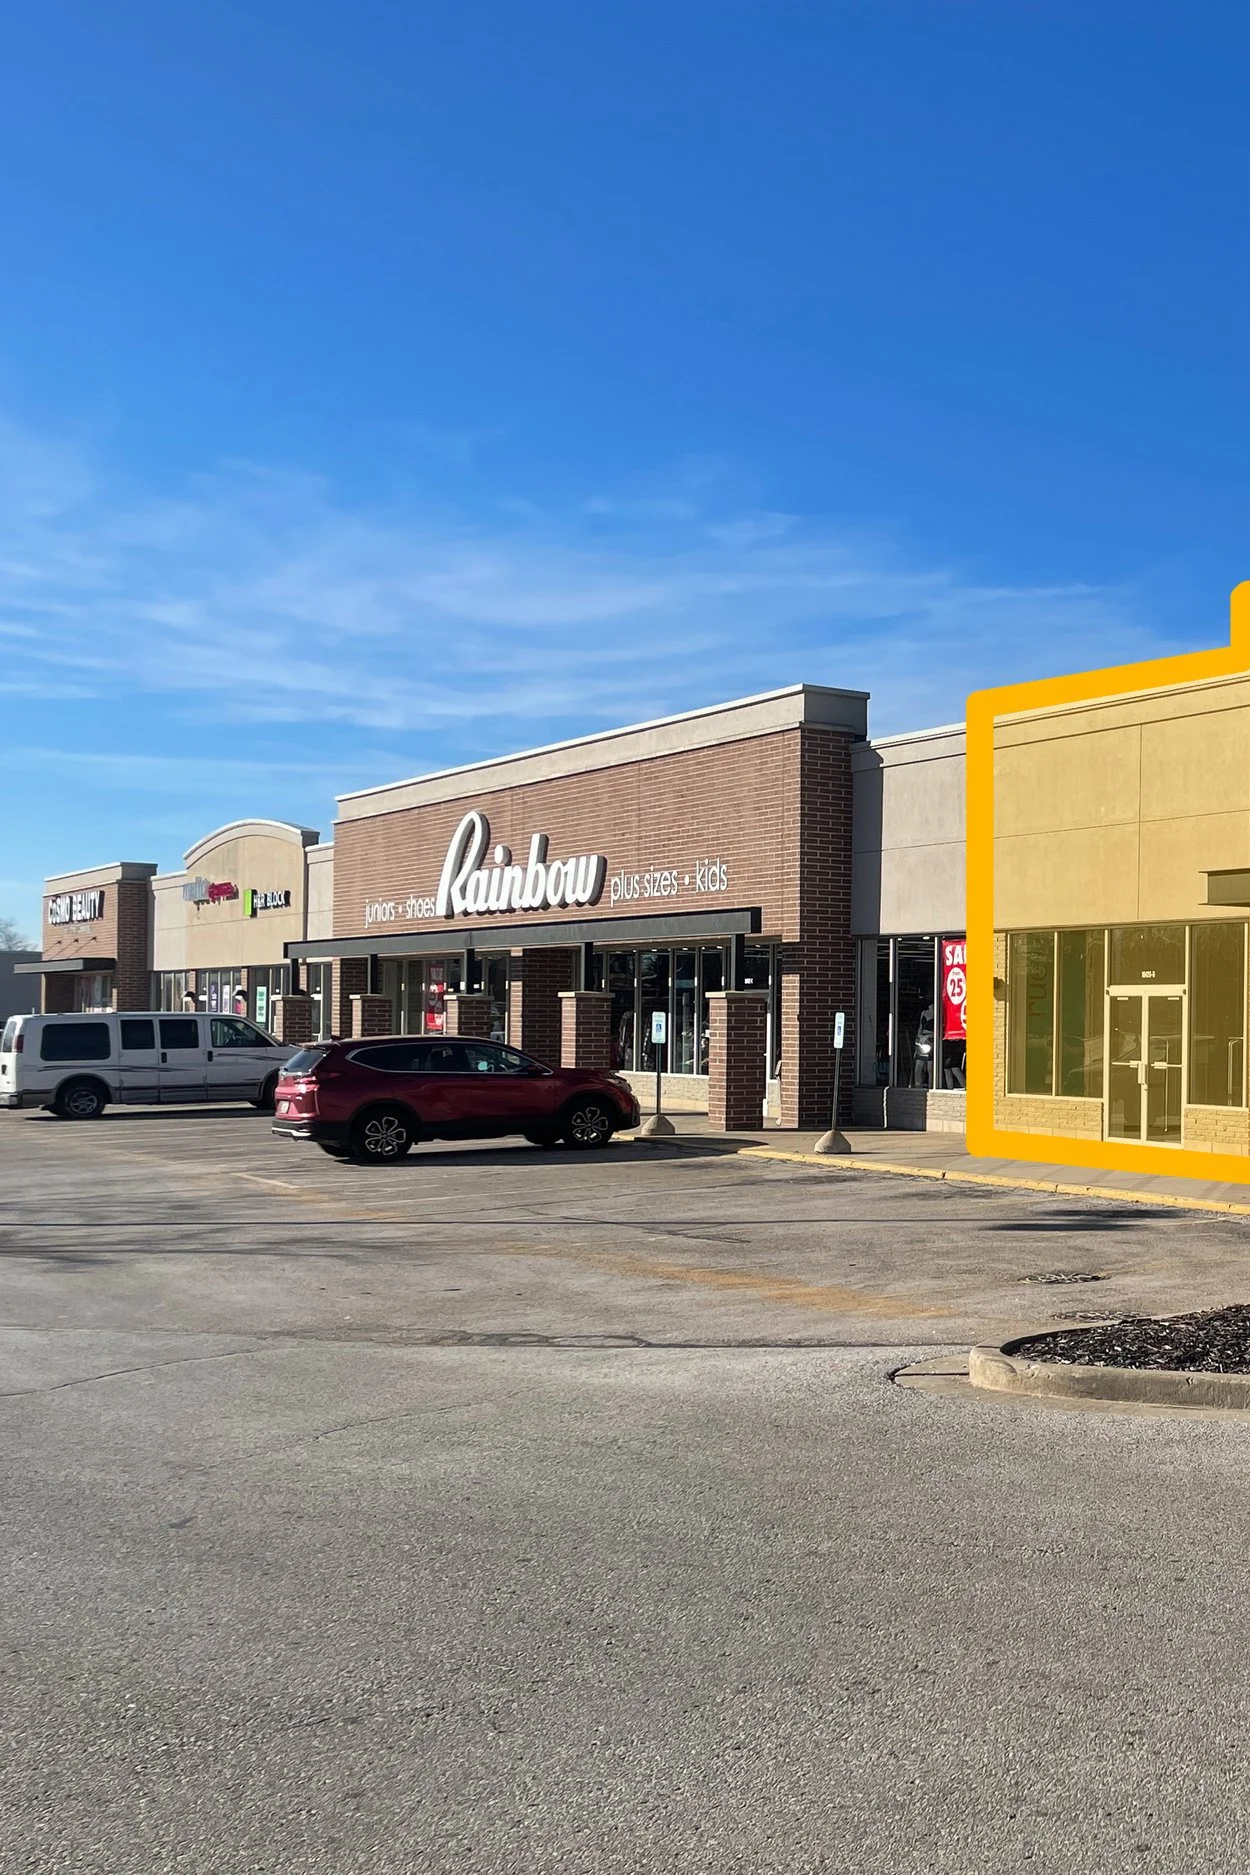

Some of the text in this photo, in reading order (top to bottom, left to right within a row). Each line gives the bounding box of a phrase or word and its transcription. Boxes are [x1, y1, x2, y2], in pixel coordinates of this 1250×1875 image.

[436, 811, 603, 917] Rainbow
[266, 890, 286, 907] BLOCK
[611, 858, 728, 908] plus sizes kids
[72, 890, 100, 921] BEAUTY
[364, 894, 435, 928] juniors shoes
[949, 978, 963, 998] 25
